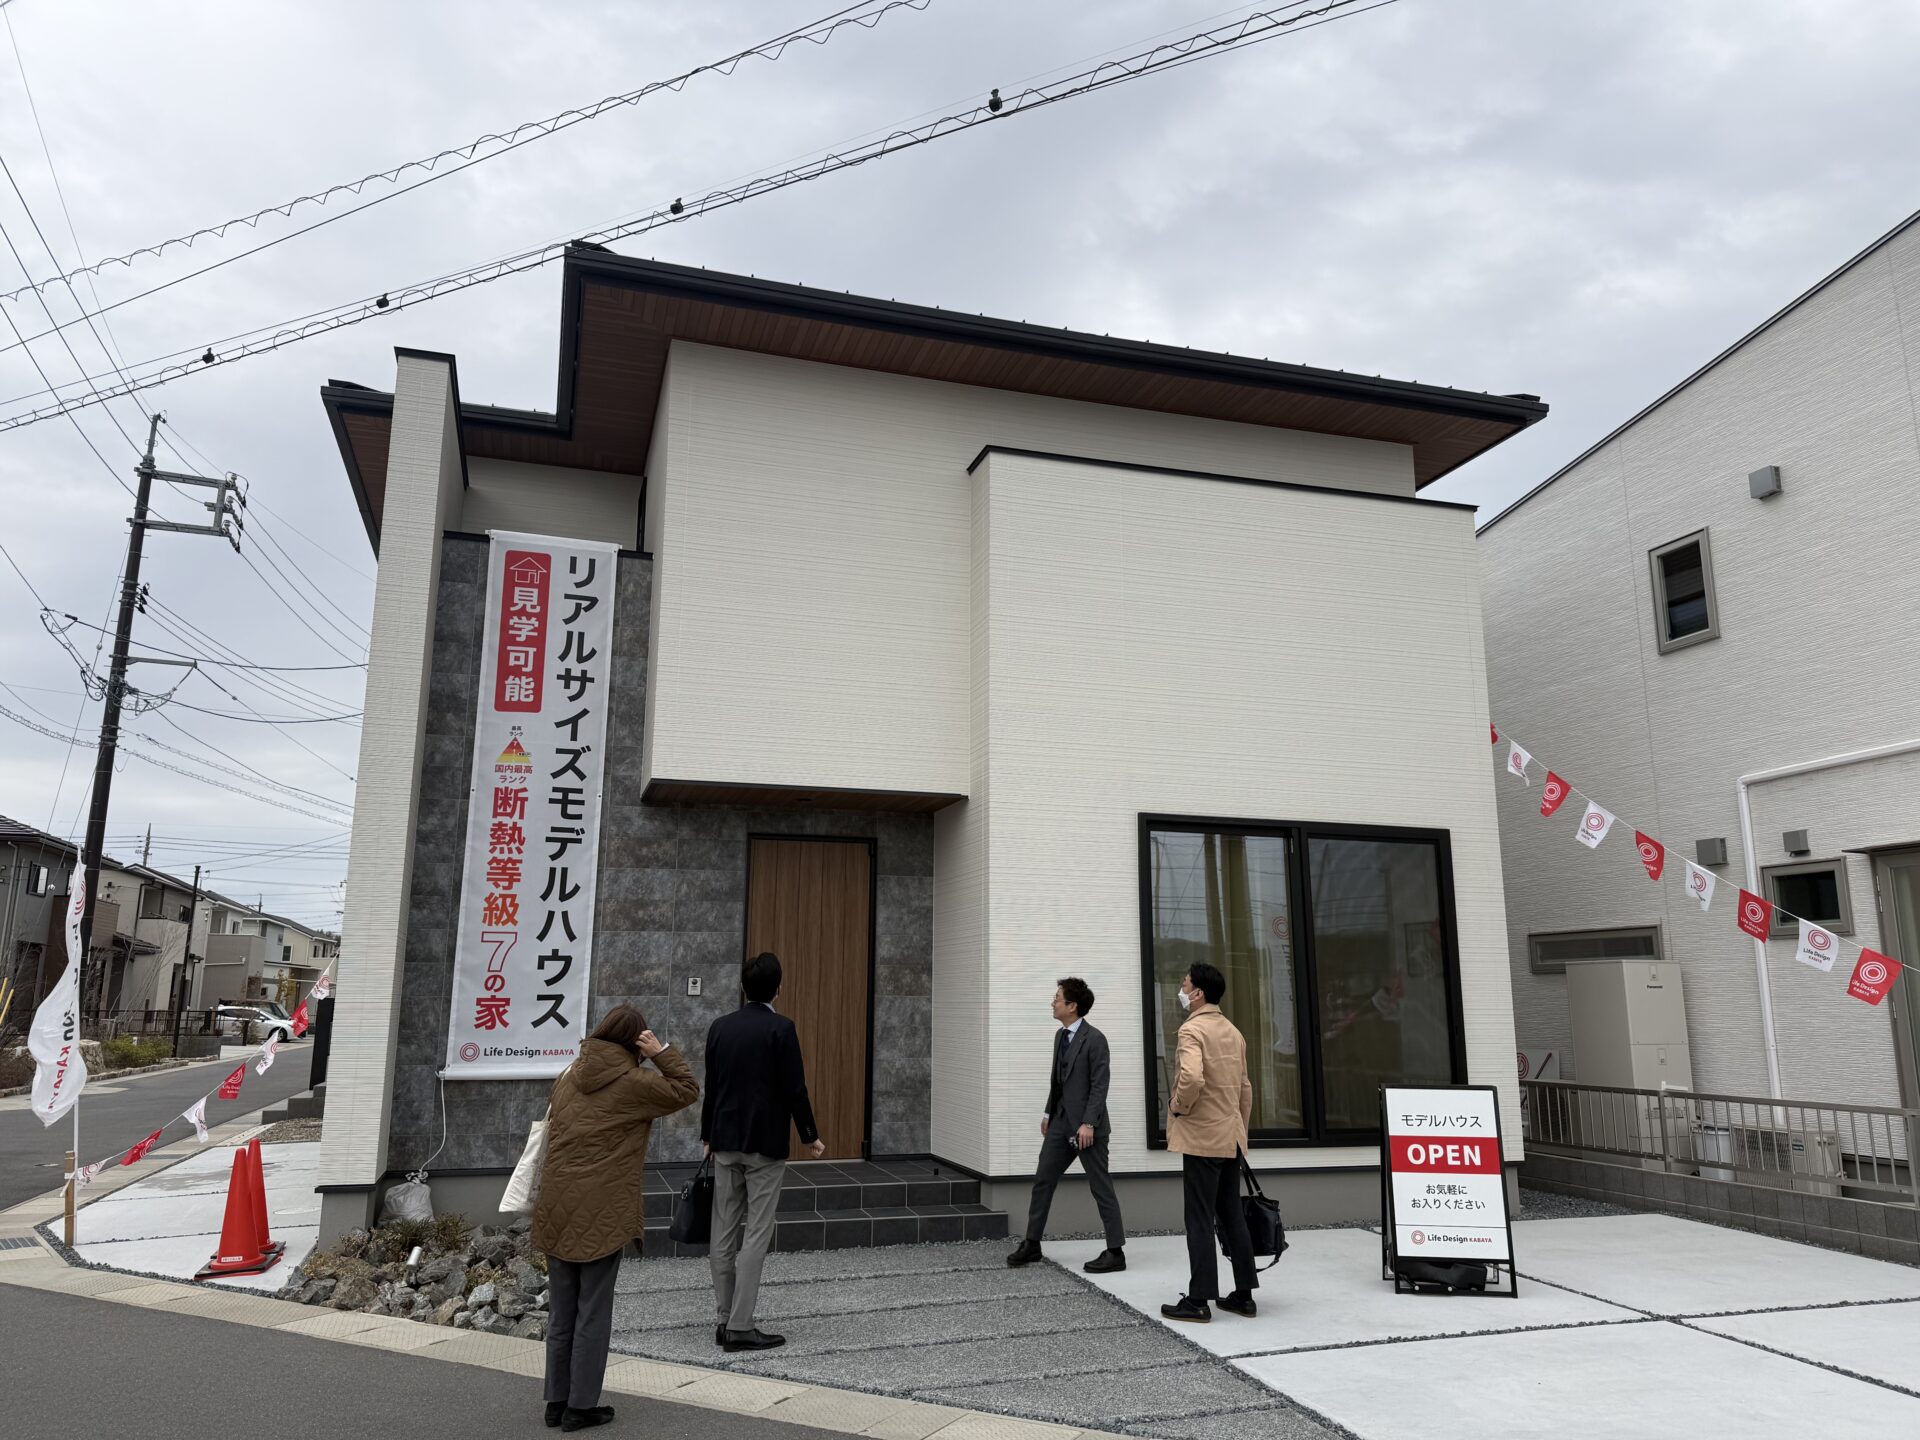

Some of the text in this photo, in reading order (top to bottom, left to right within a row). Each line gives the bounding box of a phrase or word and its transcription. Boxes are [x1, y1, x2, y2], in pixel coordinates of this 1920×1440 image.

[504, 586, 541, 703] 見学可能
[494, 764, 534, 774] 国内最高
[499, 775, 527, 784] ランク
[530, 556, 599, 1029] リアルサイズモデルハウス
[473, 786, 529, 1031] 断熱等級7の家
[483, 1046, 575, 1059] Life Design KABAYA
[1401, 1113, 1482, 1129] モデルハウス
[1407, 1143, 1481, 1166] OPEN
[1425, 1183, 1468, 1196] お気軽に
[1411, 1198, 1486, 1210] お入りください
[1427, 1234, 1442, 1242] Life
[1443, 1235, 1468, 1244] Design
